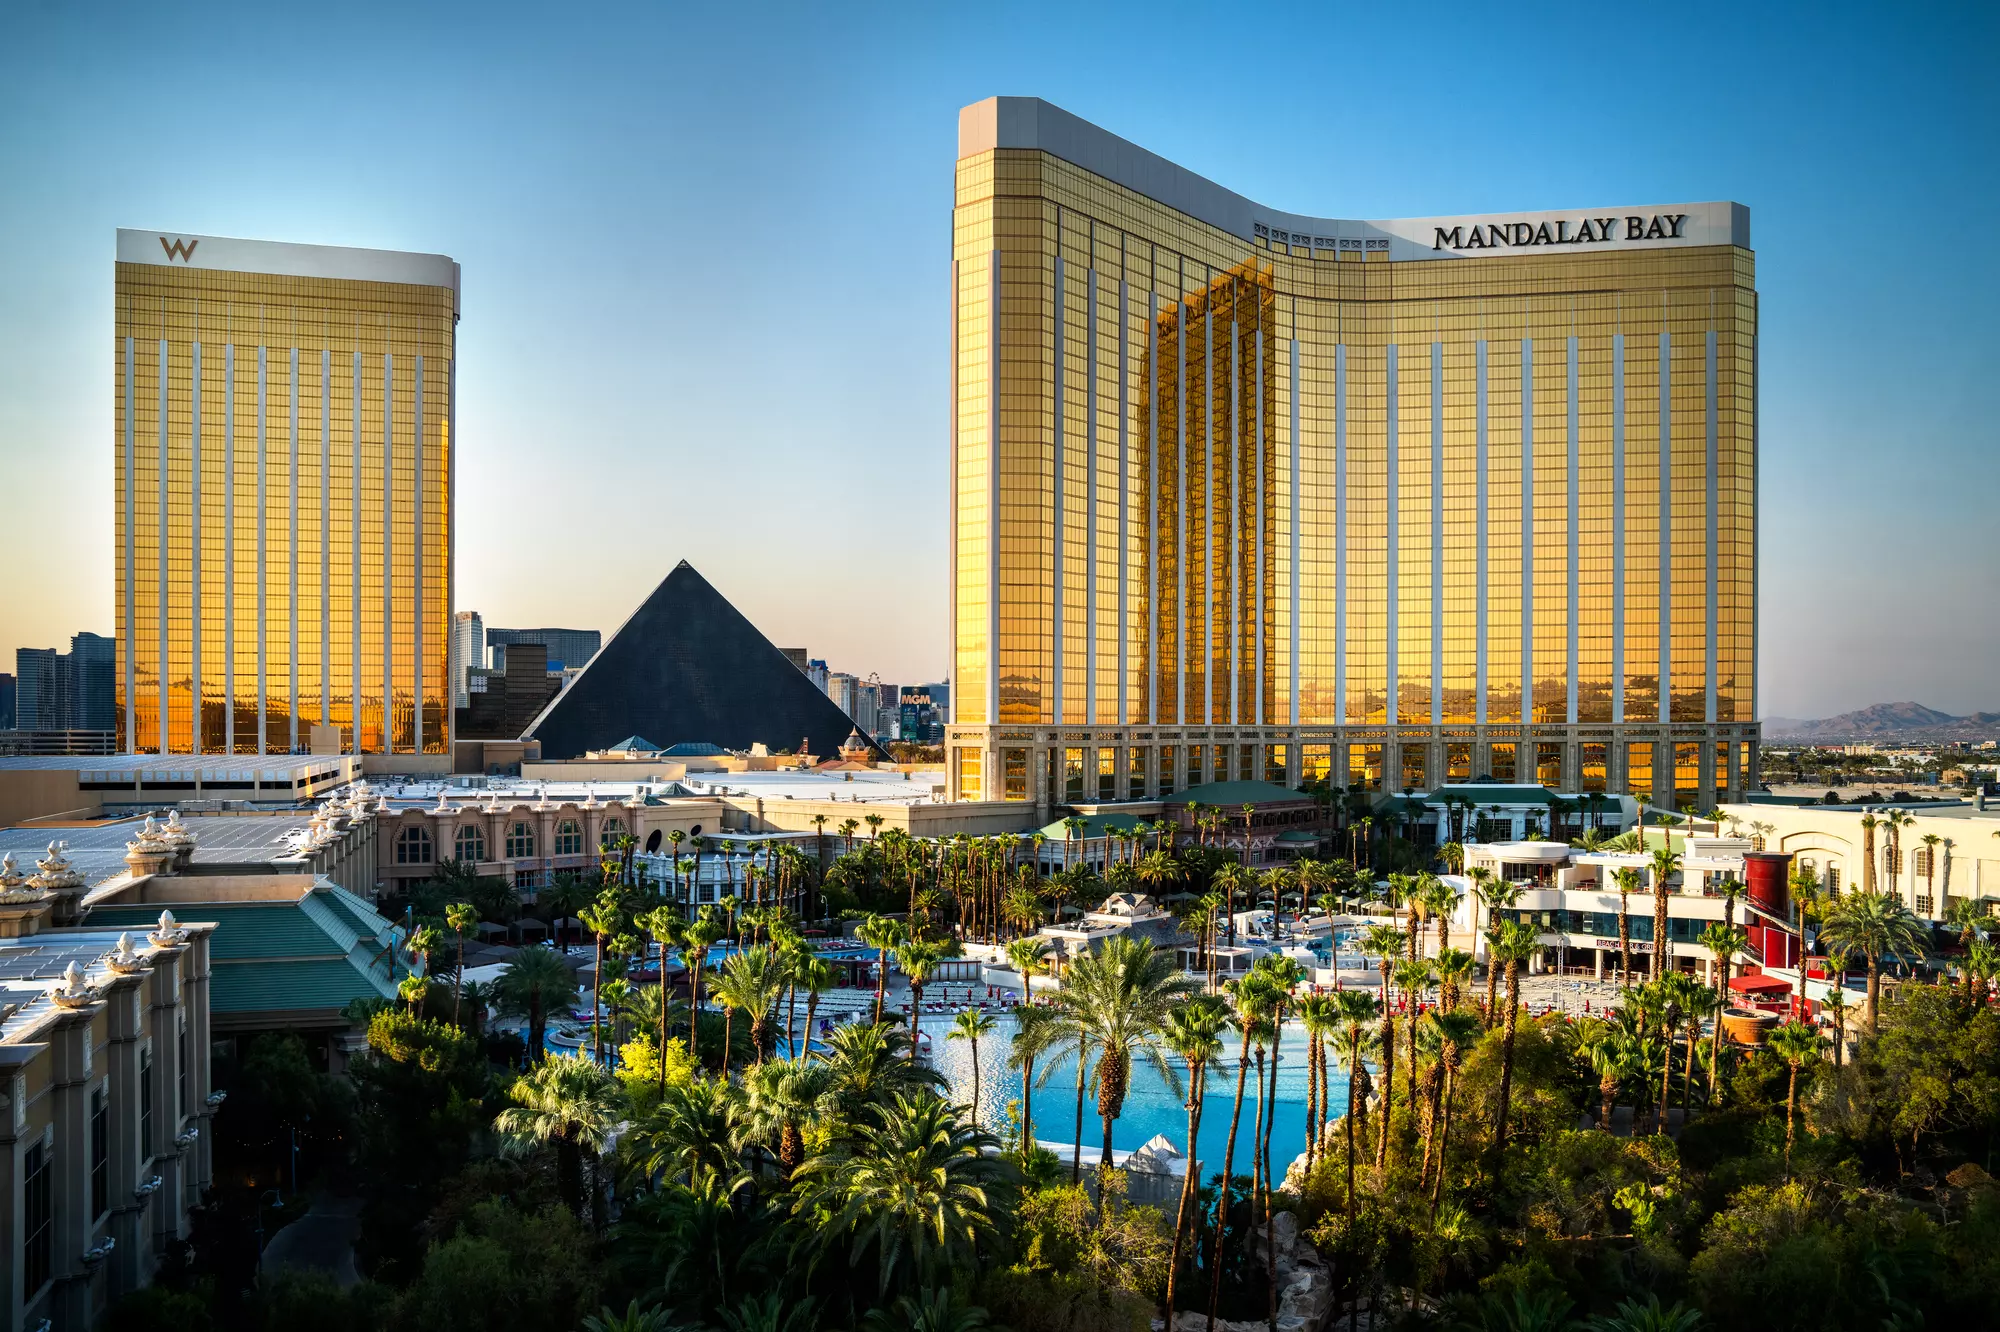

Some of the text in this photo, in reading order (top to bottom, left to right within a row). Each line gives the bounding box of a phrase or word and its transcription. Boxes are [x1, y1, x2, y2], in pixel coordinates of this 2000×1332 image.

[1433, 215, 1686, 250] MANDALAY BAY
[159, 236, 198, 263] W
[901, 695, 930, 705] MGM
[1597, 940, 1620, 948] BEACH
